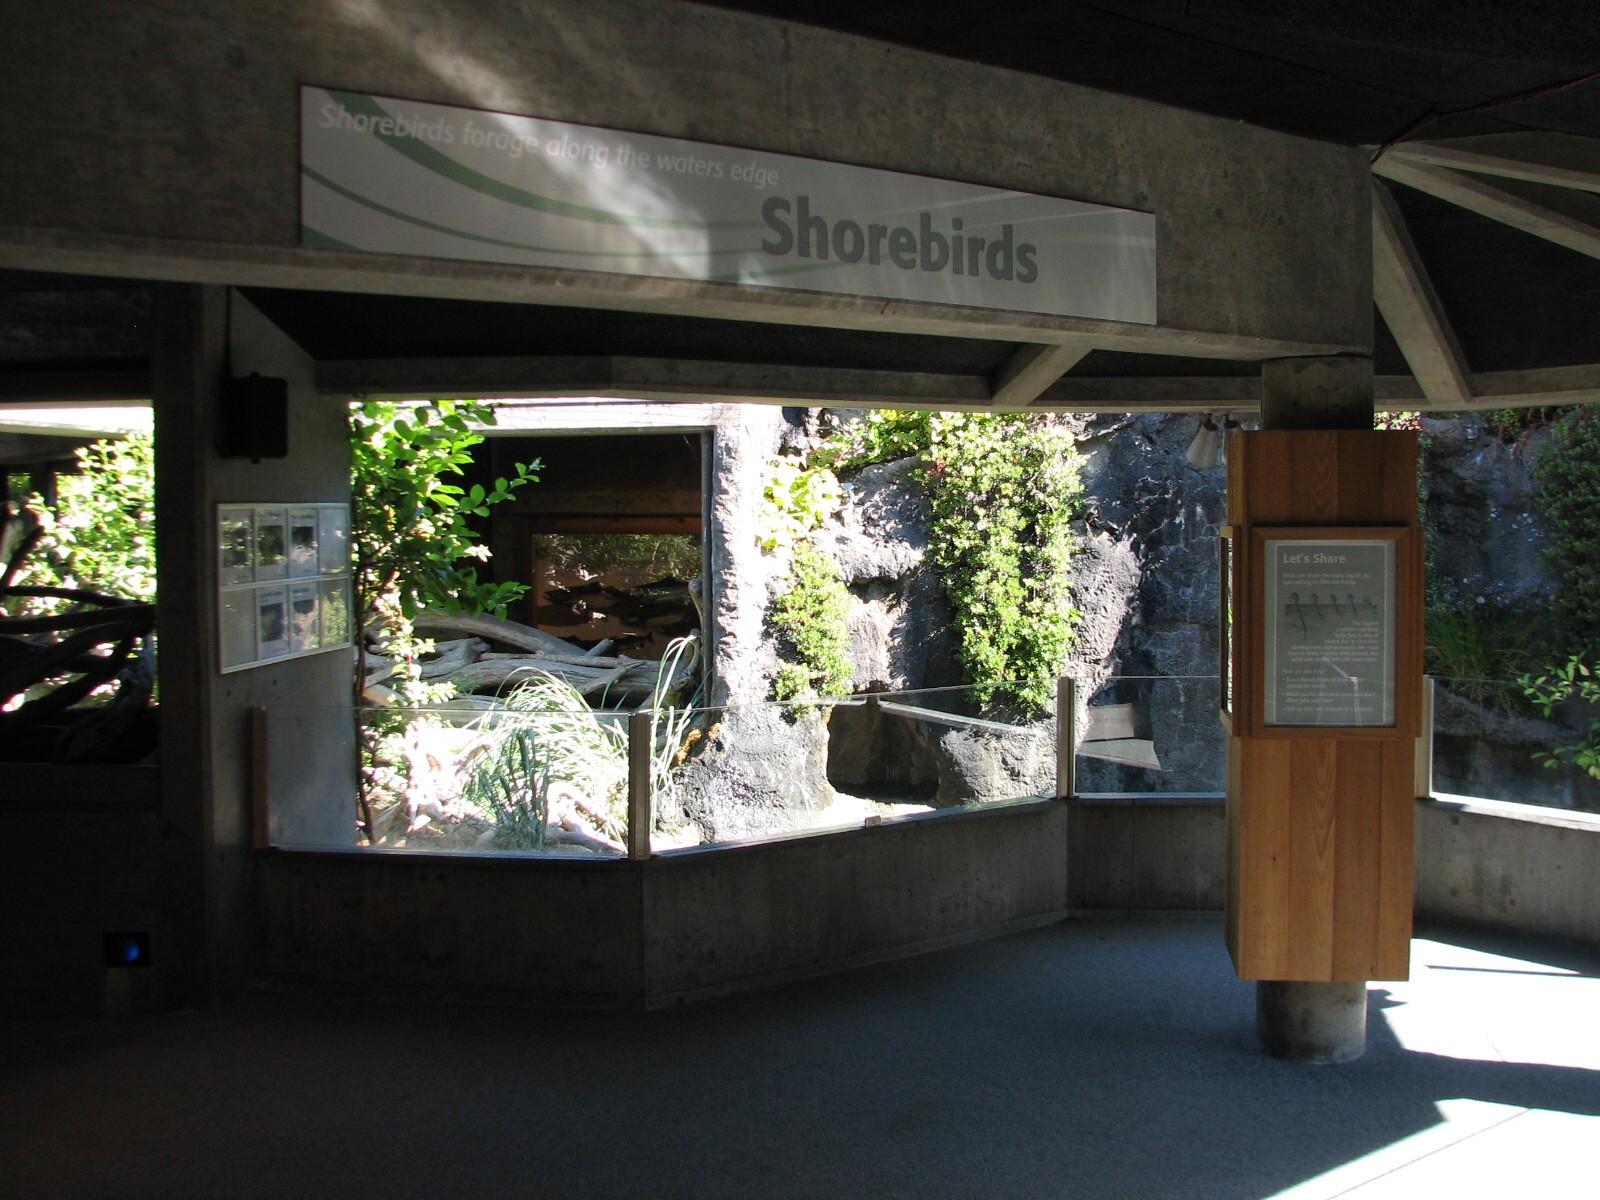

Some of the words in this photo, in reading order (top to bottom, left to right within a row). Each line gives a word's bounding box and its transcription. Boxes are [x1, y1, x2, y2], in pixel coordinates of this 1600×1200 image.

[319, 104, 454, 143] Shorebirds
[462, 121, 539, 158] forage
[546, 134, 608, 169] along
[617, 143, 650, 166] the
[657, 152, 724, 178] waters
[731, 161, 779, 190] edge
[761, 195, 1039, 284] Shorebirds
[1283, 553, 1310, 564] Let's
[1312, 552, 1346, 564] Share
